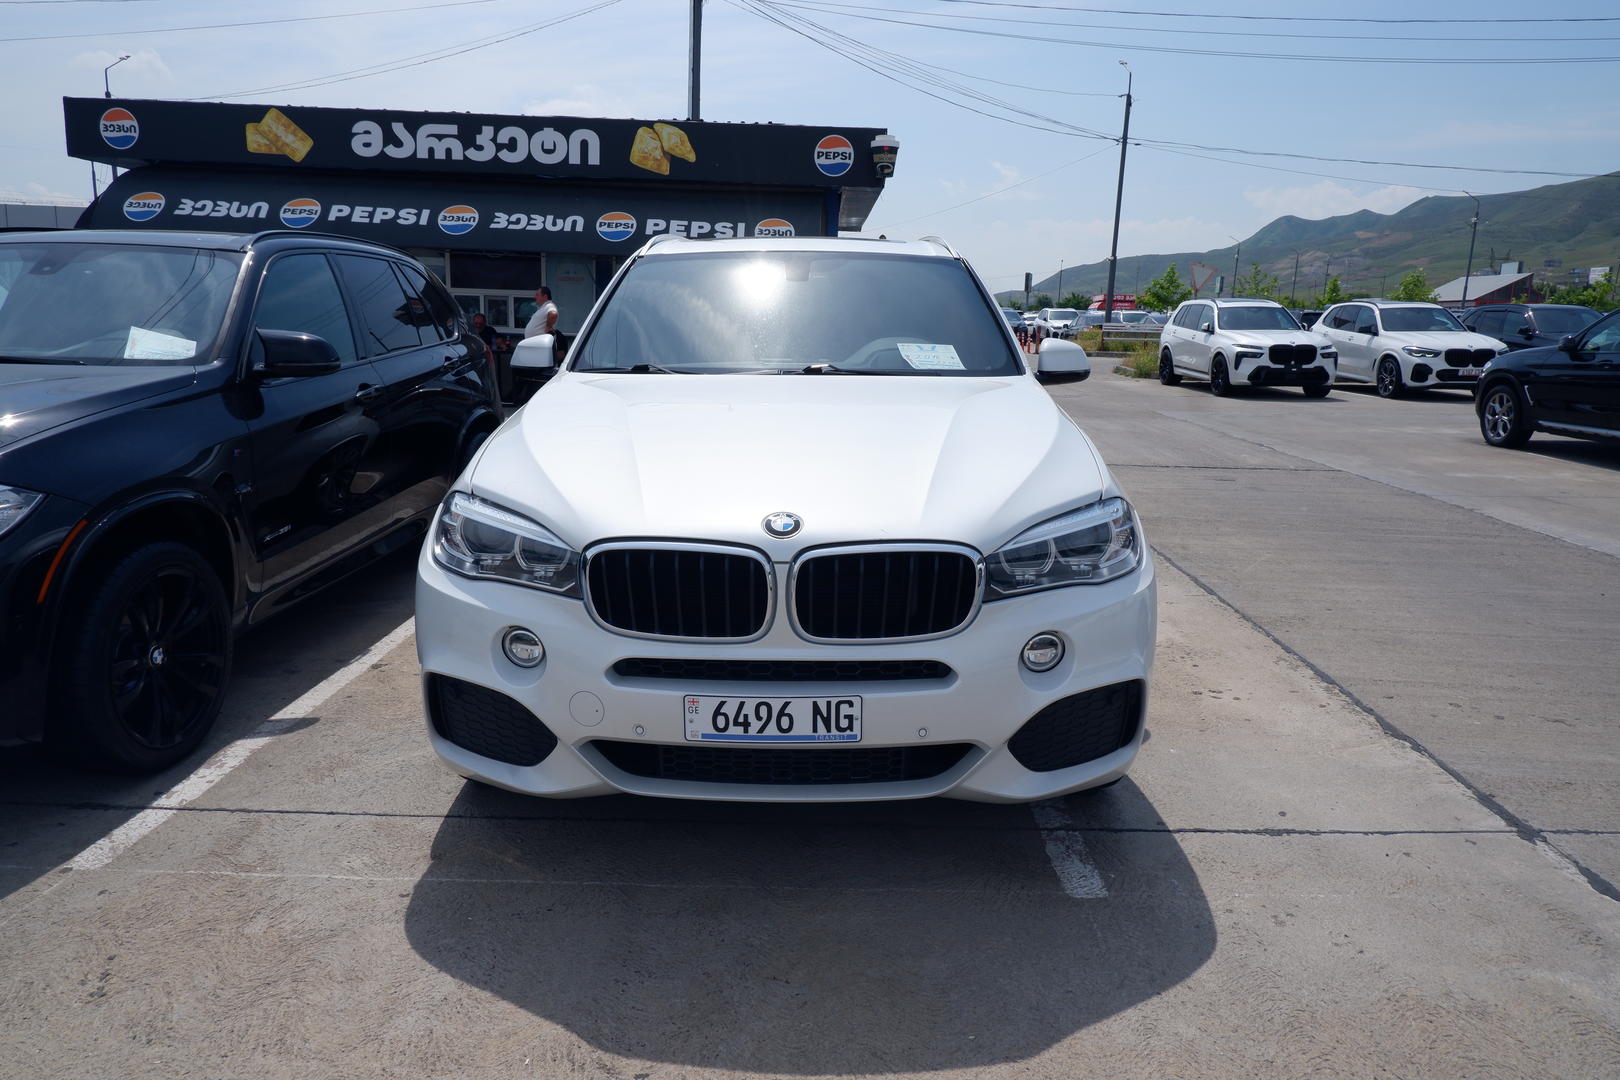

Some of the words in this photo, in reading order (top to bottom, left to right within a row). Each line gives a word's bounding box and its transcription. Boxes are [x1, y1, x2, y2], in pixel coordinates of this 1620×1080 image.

[102, 123, 137, 134] პეპსი
[351, 120, 600, 166] მარკეტი
[816, 151, 852, 161] PEPSI
[126, 201, 162, 210] პეპსი
[173, 198, 270, 219] პეპსი
[282, 207, 319, 216] PEPSI
[327, 204, 431, 226] PEPSI
[440, 214, 477, 223] პეპსი
[489, 212, 585, 232] პეპსი
[598, 221, 634, 230] PEPSI
[645, 218, 746, 238] PEPSI
[687, 706, 699, 715] GE
[712, 700, 794, 733] 6496
[811, 700, 854, 733] NG
